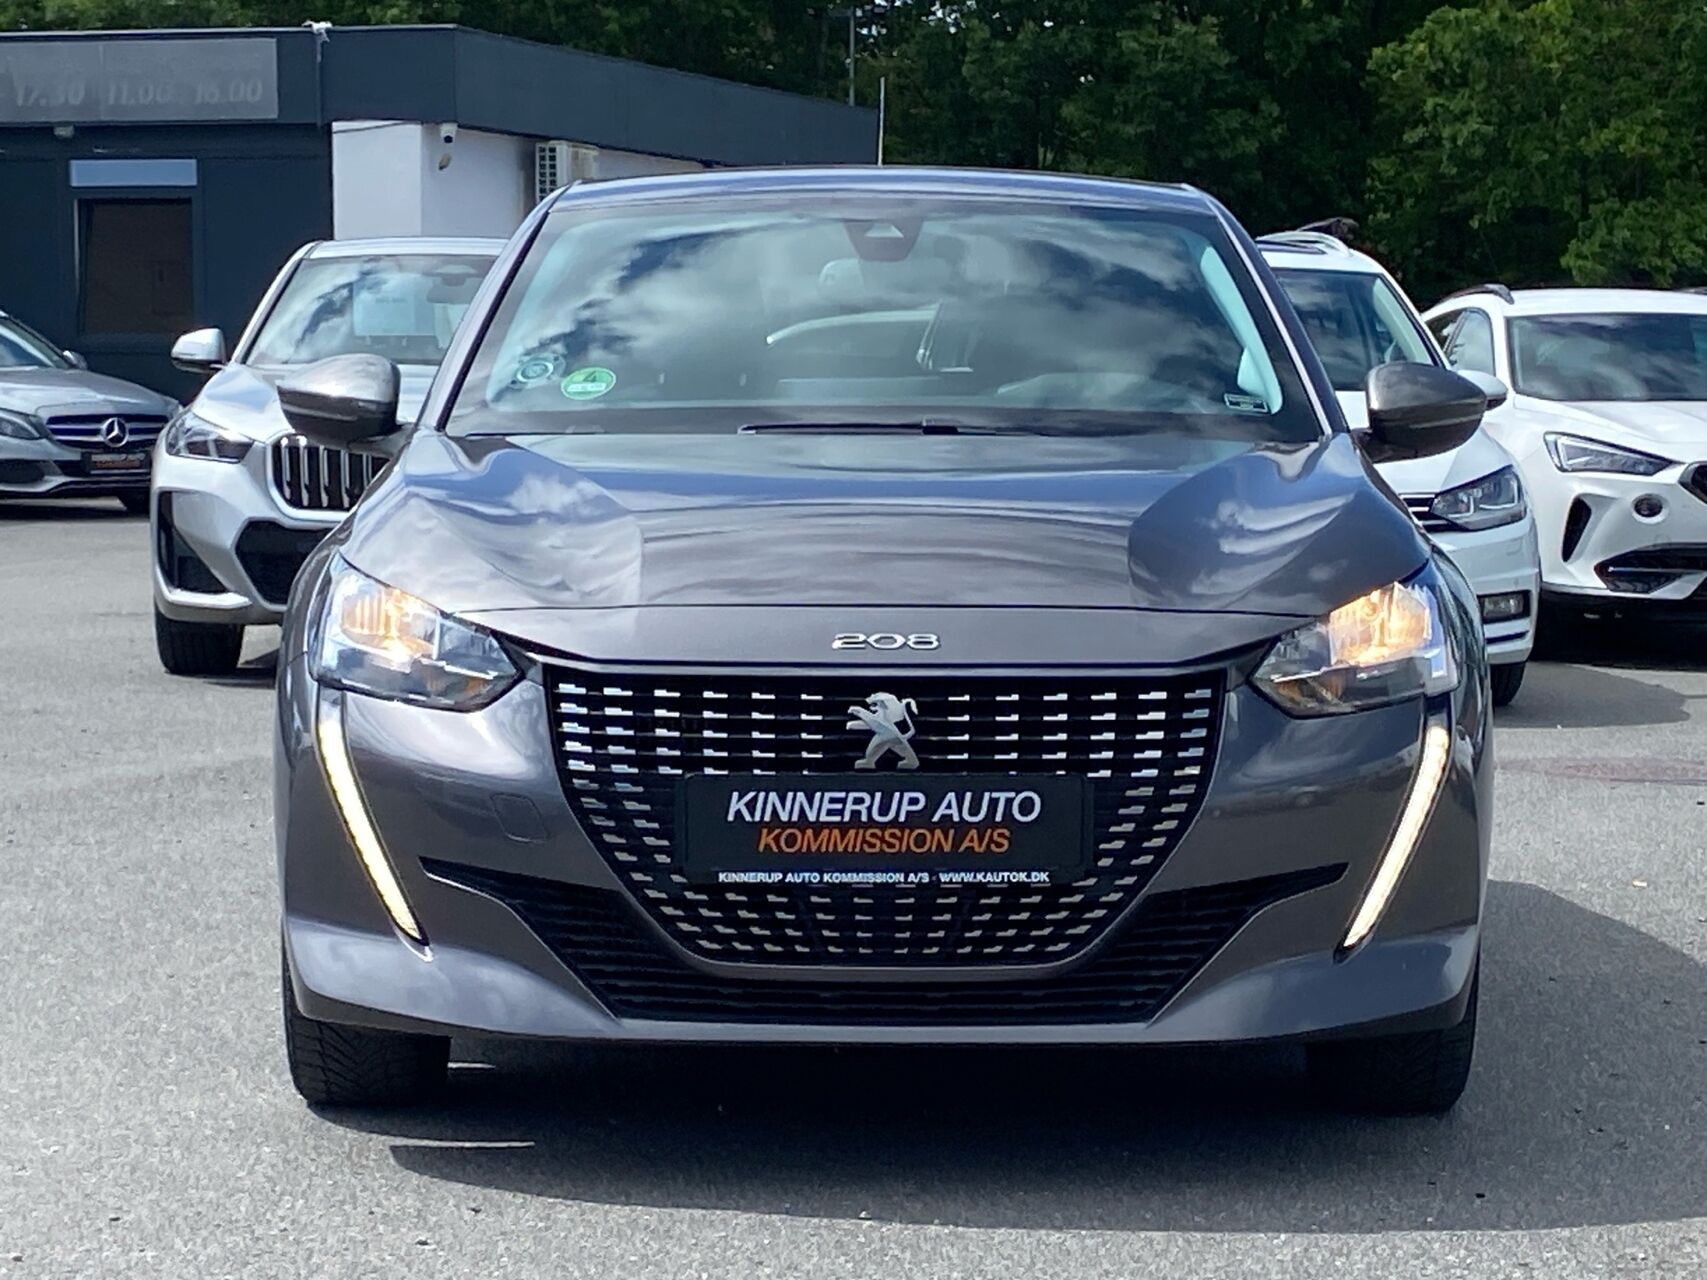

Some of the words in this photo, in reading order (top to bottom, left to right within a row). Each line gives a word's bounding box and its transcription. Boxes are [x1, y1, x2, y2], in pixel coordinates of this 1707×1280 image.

[831, 632, 940, 651] 208
[727, 790, 926, 823] KINNERUP
[932, 790, 1043, 823] AUTO
[758, 828, 955, 853] KOMMISSION
[957, 828, 1012, 853] A/S
[718, 871, 783, 883] KINNERUP
[785, 871, 821, 883] AUTO
[823, 871, 905, 884] KOMMISSION
[907, 872, 930, 883] A/S
[938, 871, 1050, 883] WWW.KAUTOK.DK
